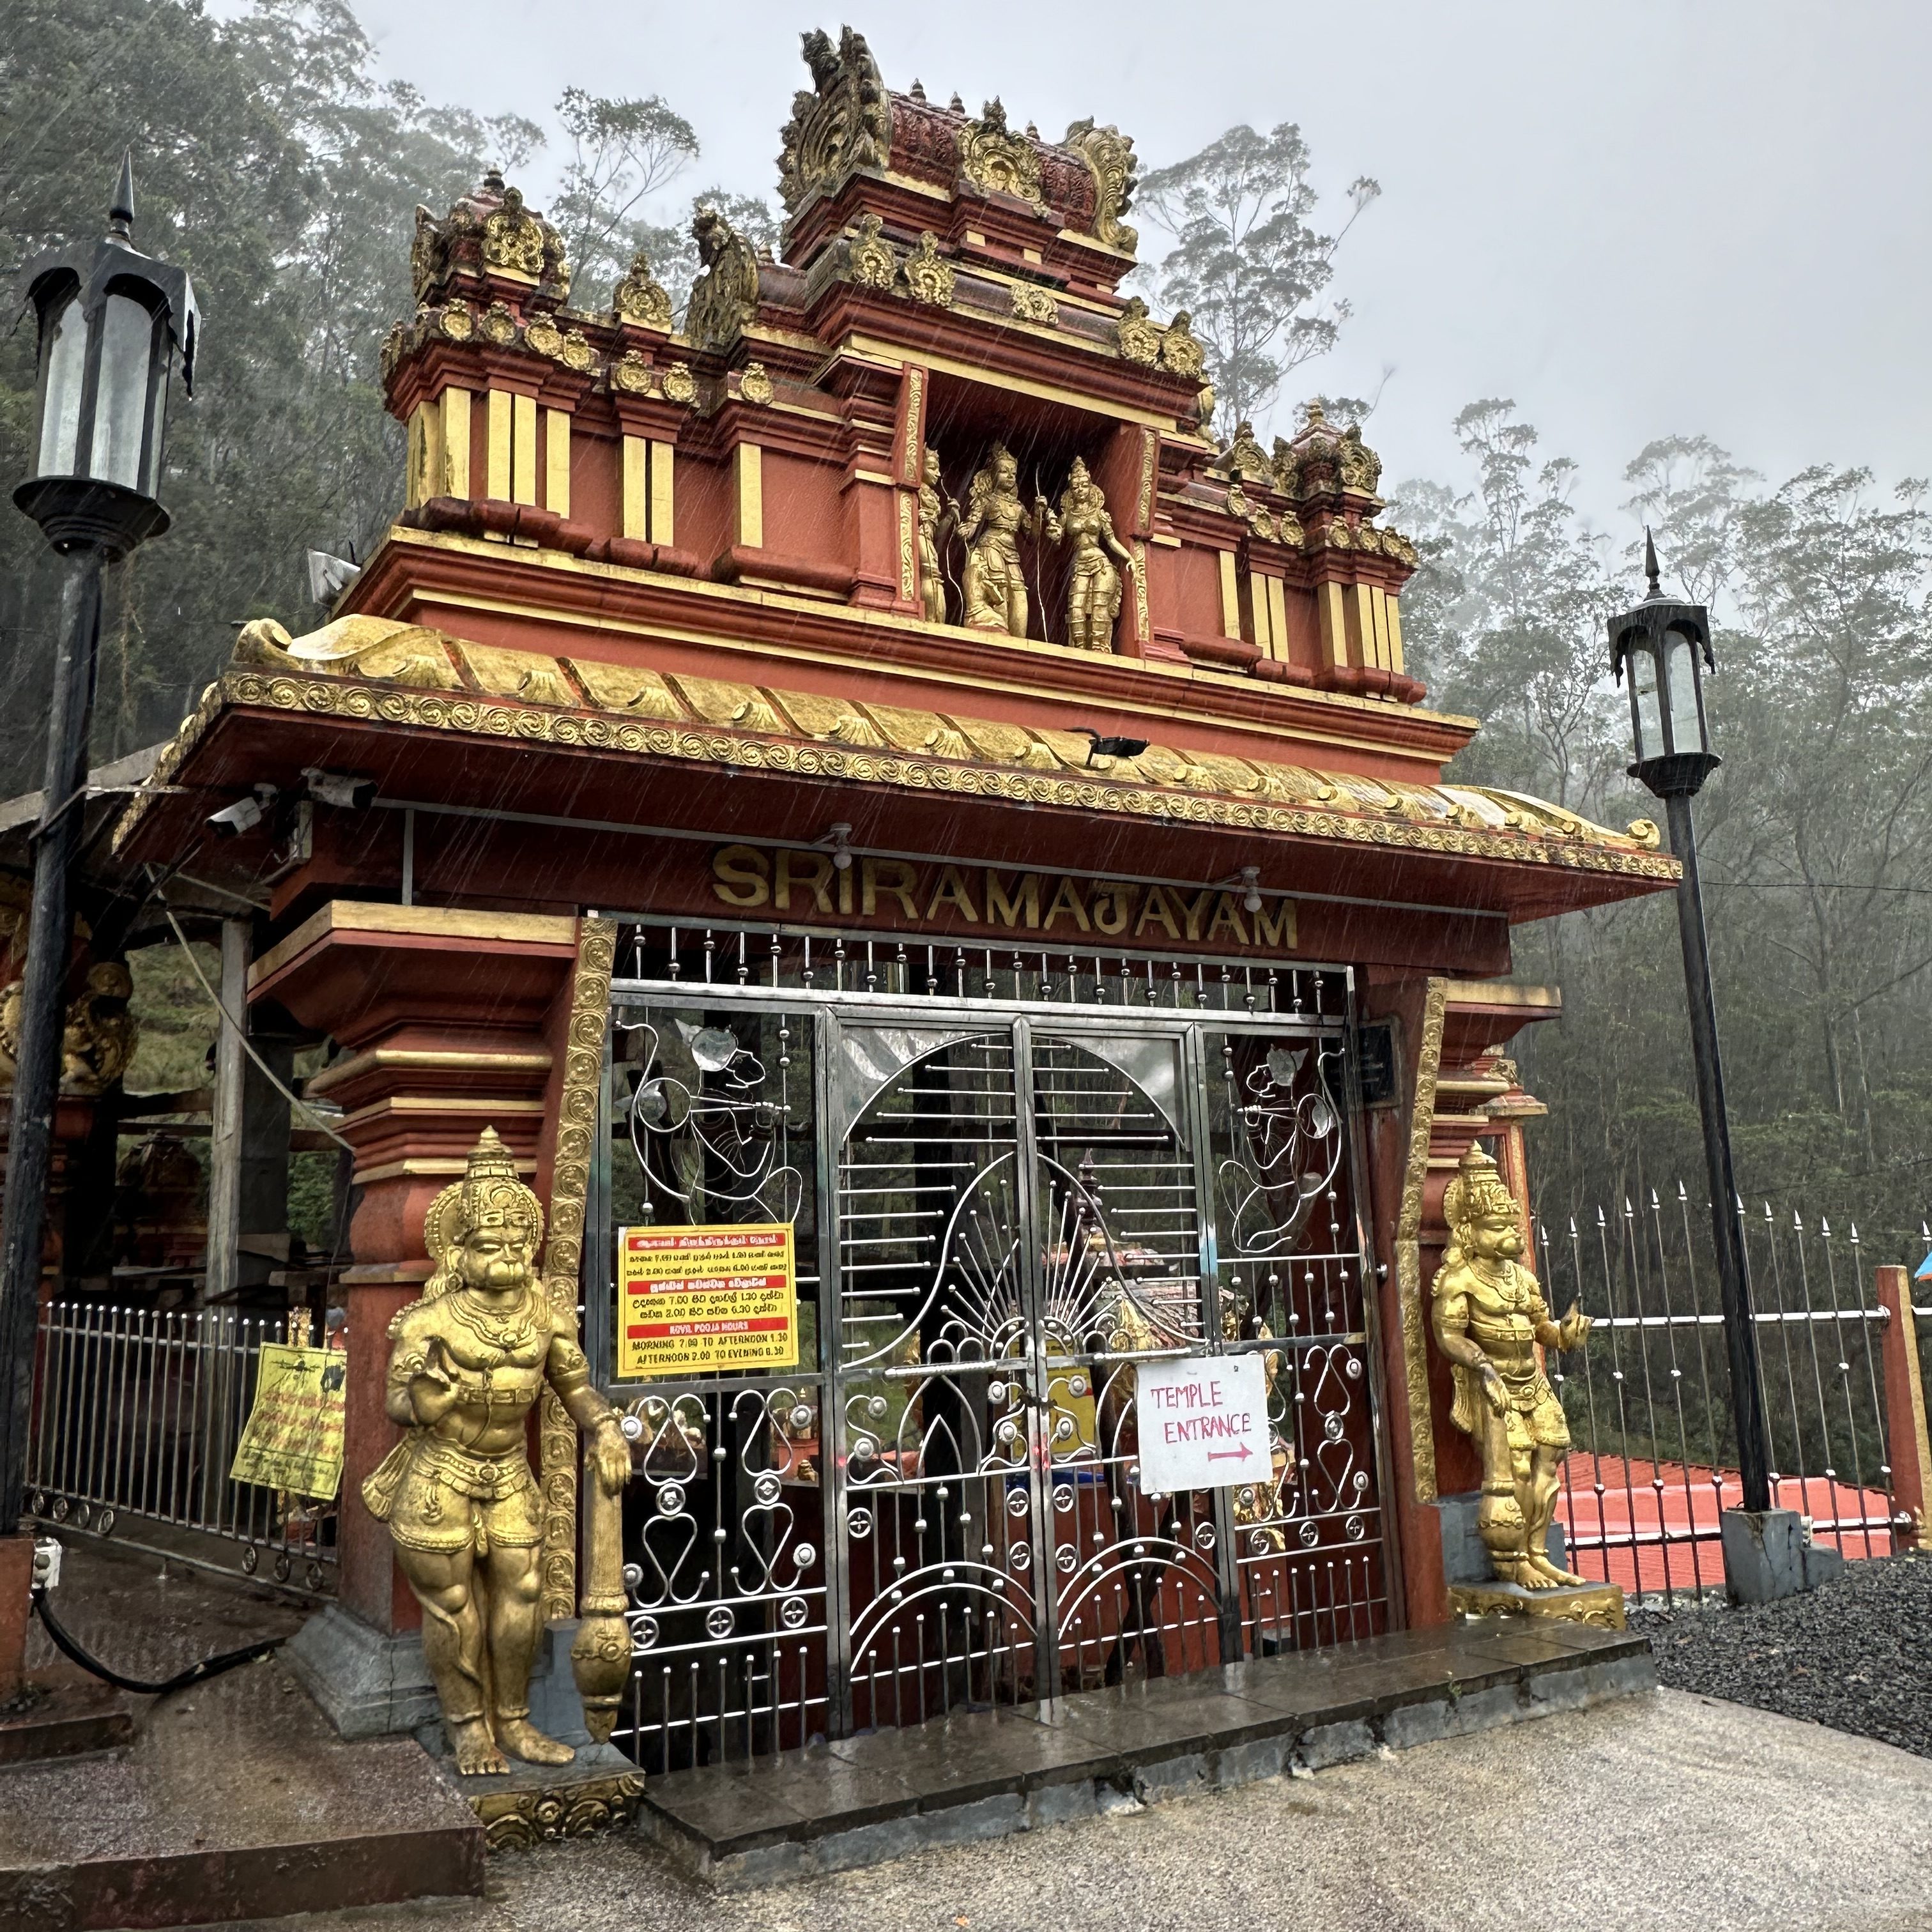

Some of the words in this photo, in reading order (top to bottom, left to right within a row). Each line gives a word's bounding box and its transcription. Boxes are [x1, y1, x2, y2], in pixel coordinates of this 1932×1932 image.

[712, 844, 1298, 950] SRIRAMAJAYAM
[632, 1339, 674, 1351] MORNING
[702, 1337, 713, 1347] TO
[718, 1334, 767, 1346] AFTERNOON
[637, 1352, 689, 1365] AFTERNOON
[715, 1350, 726, 1360] TO
[728, 1347, 763, 1359] EVENING
[1150, 1381, 1223, 1409] TEMPLE
[1163, 1413, 1252, 1444] ENTRANCE
